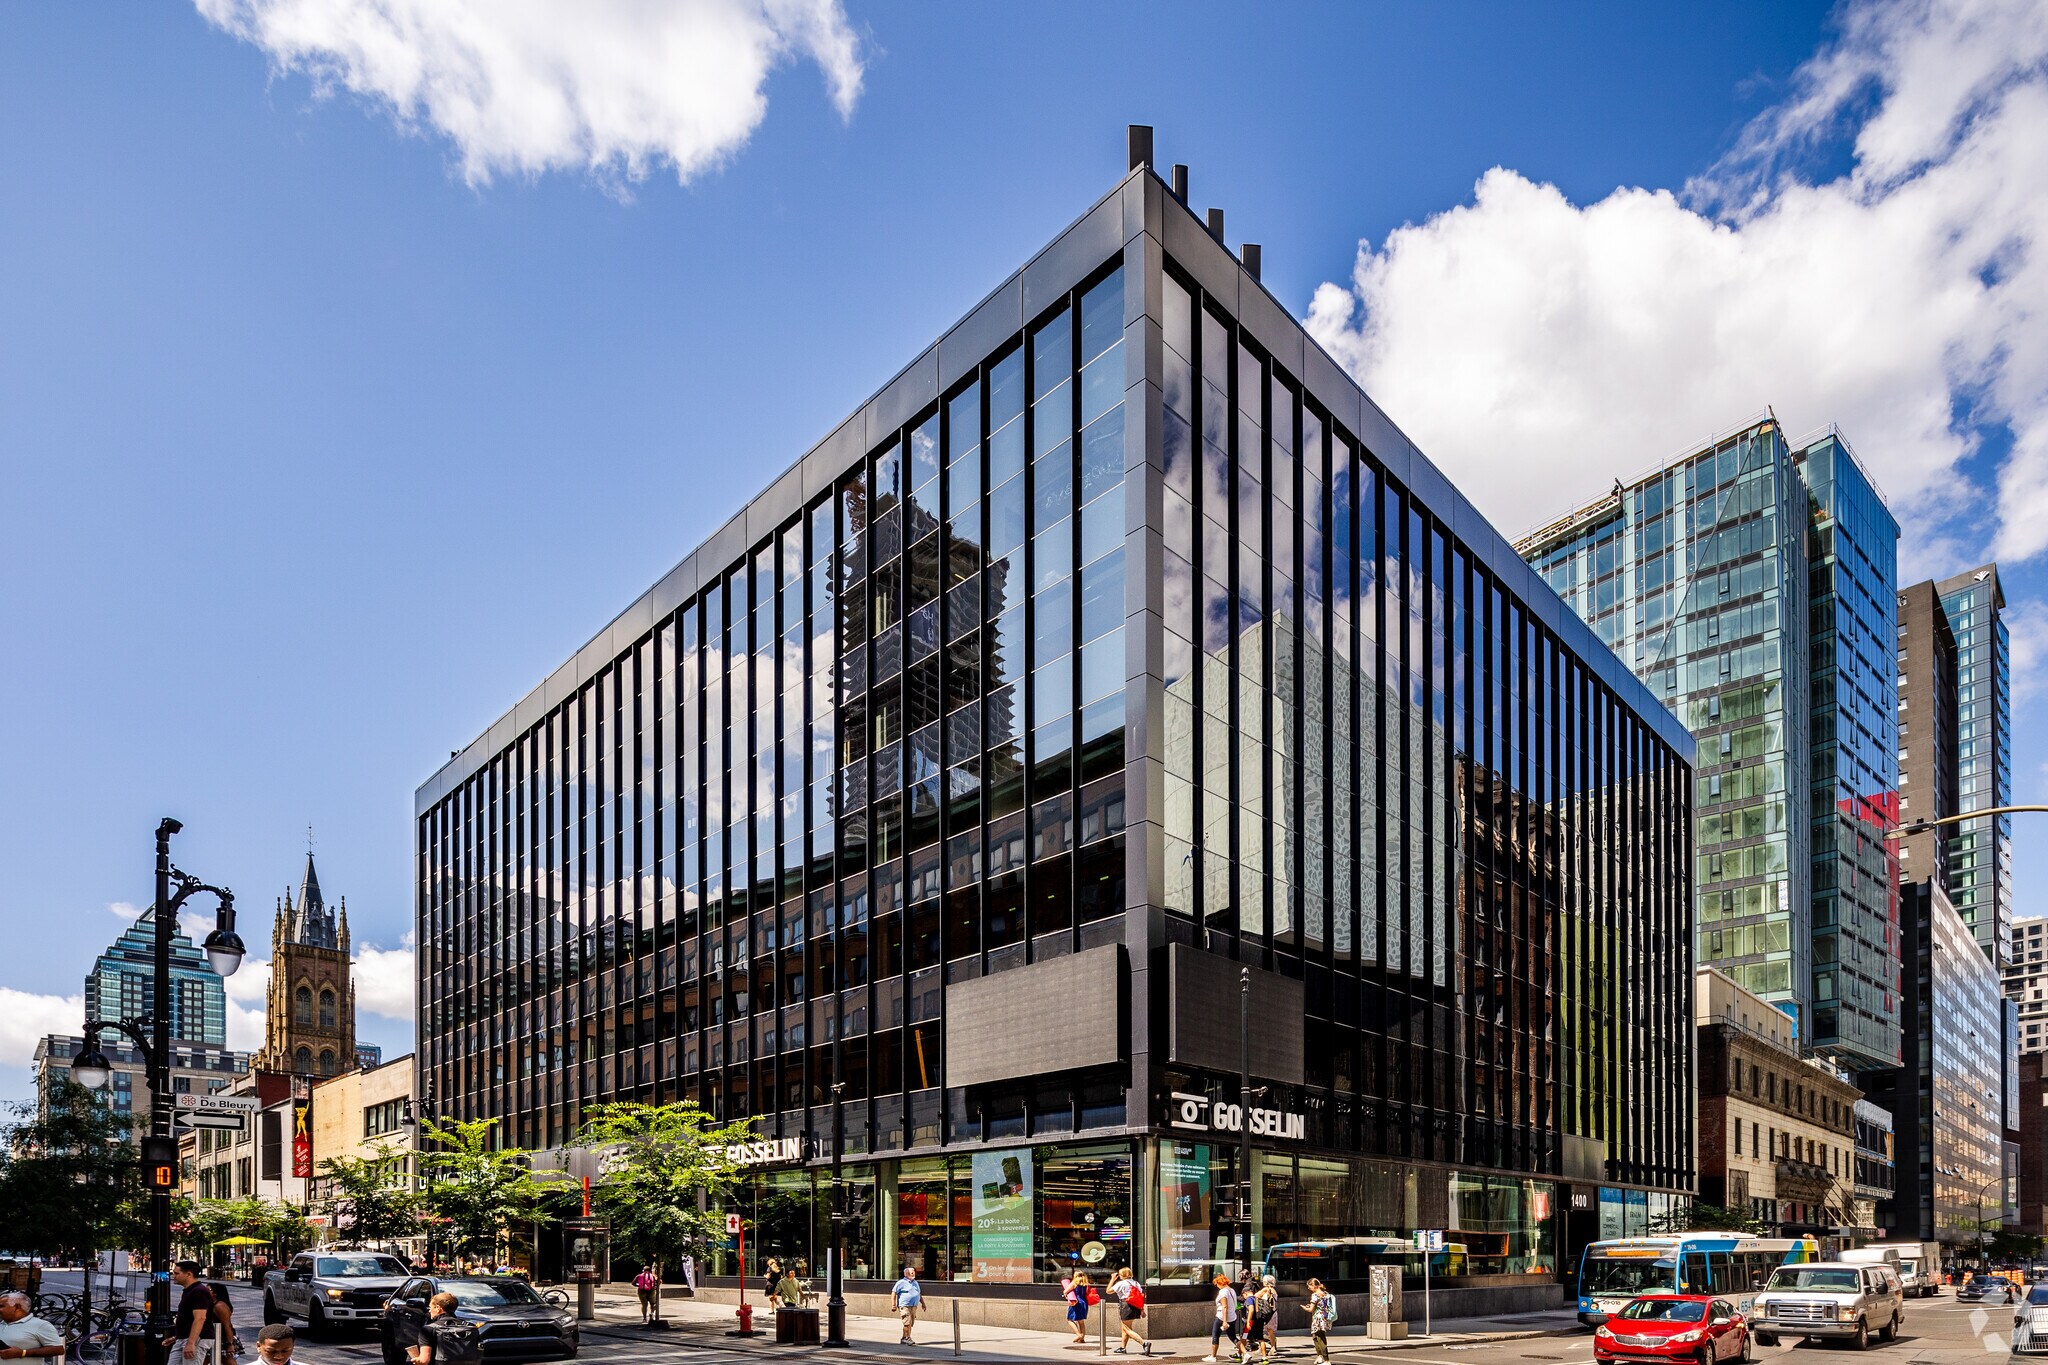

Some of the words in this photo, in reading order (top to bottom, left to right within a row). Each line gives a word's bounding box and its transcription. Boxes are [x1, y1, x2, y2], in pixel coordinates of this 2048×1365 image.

[200, 1099, 216, 1107] De
[219, 1100, 255, 1110] Bleury
[156, 1166, 171, 1186] 10
[1571, 1194, 1587, 1207] 1400
[977, 1262, 988, 1278] 3
